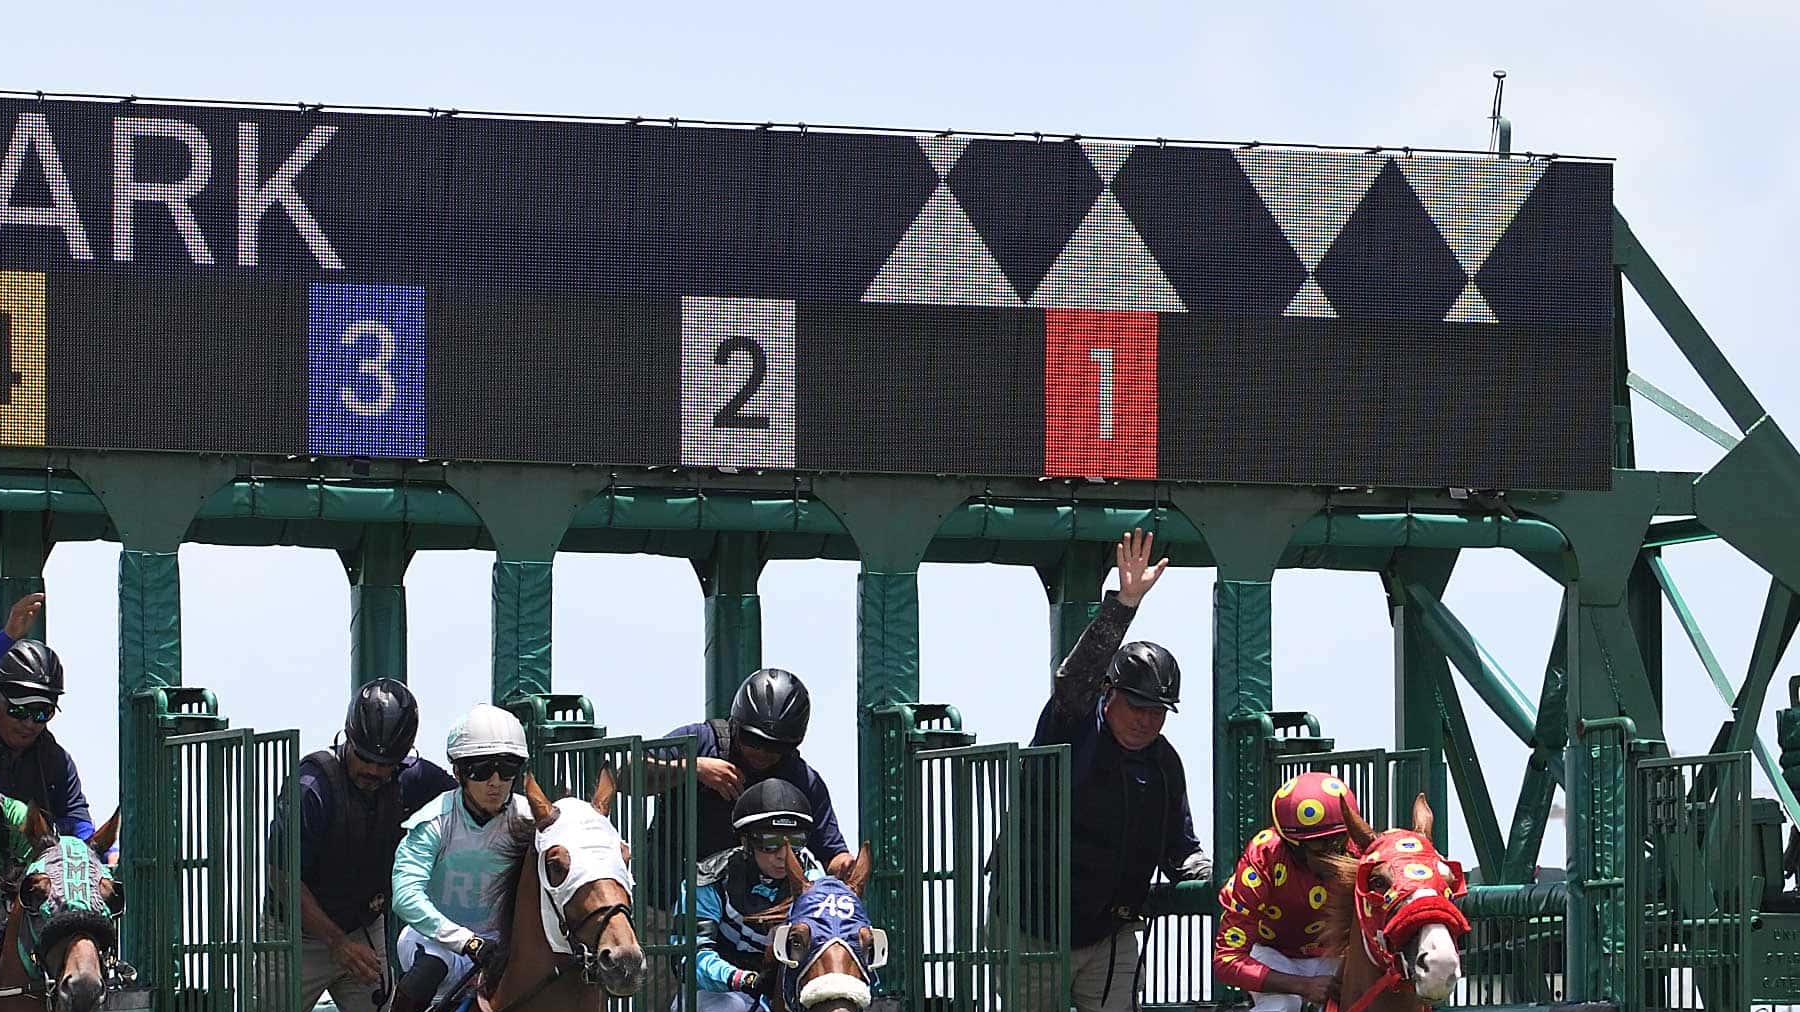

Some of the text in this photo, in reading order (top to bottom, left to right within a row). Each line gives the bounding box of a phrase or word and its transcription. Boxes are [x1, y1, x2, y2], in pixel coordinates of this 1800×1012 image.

[340, 318, 397, 416] 3
[712, 334, 771, 429] 2
[1088, 347, 1115, 440] 1
[813, 893, 855, 920] AS
